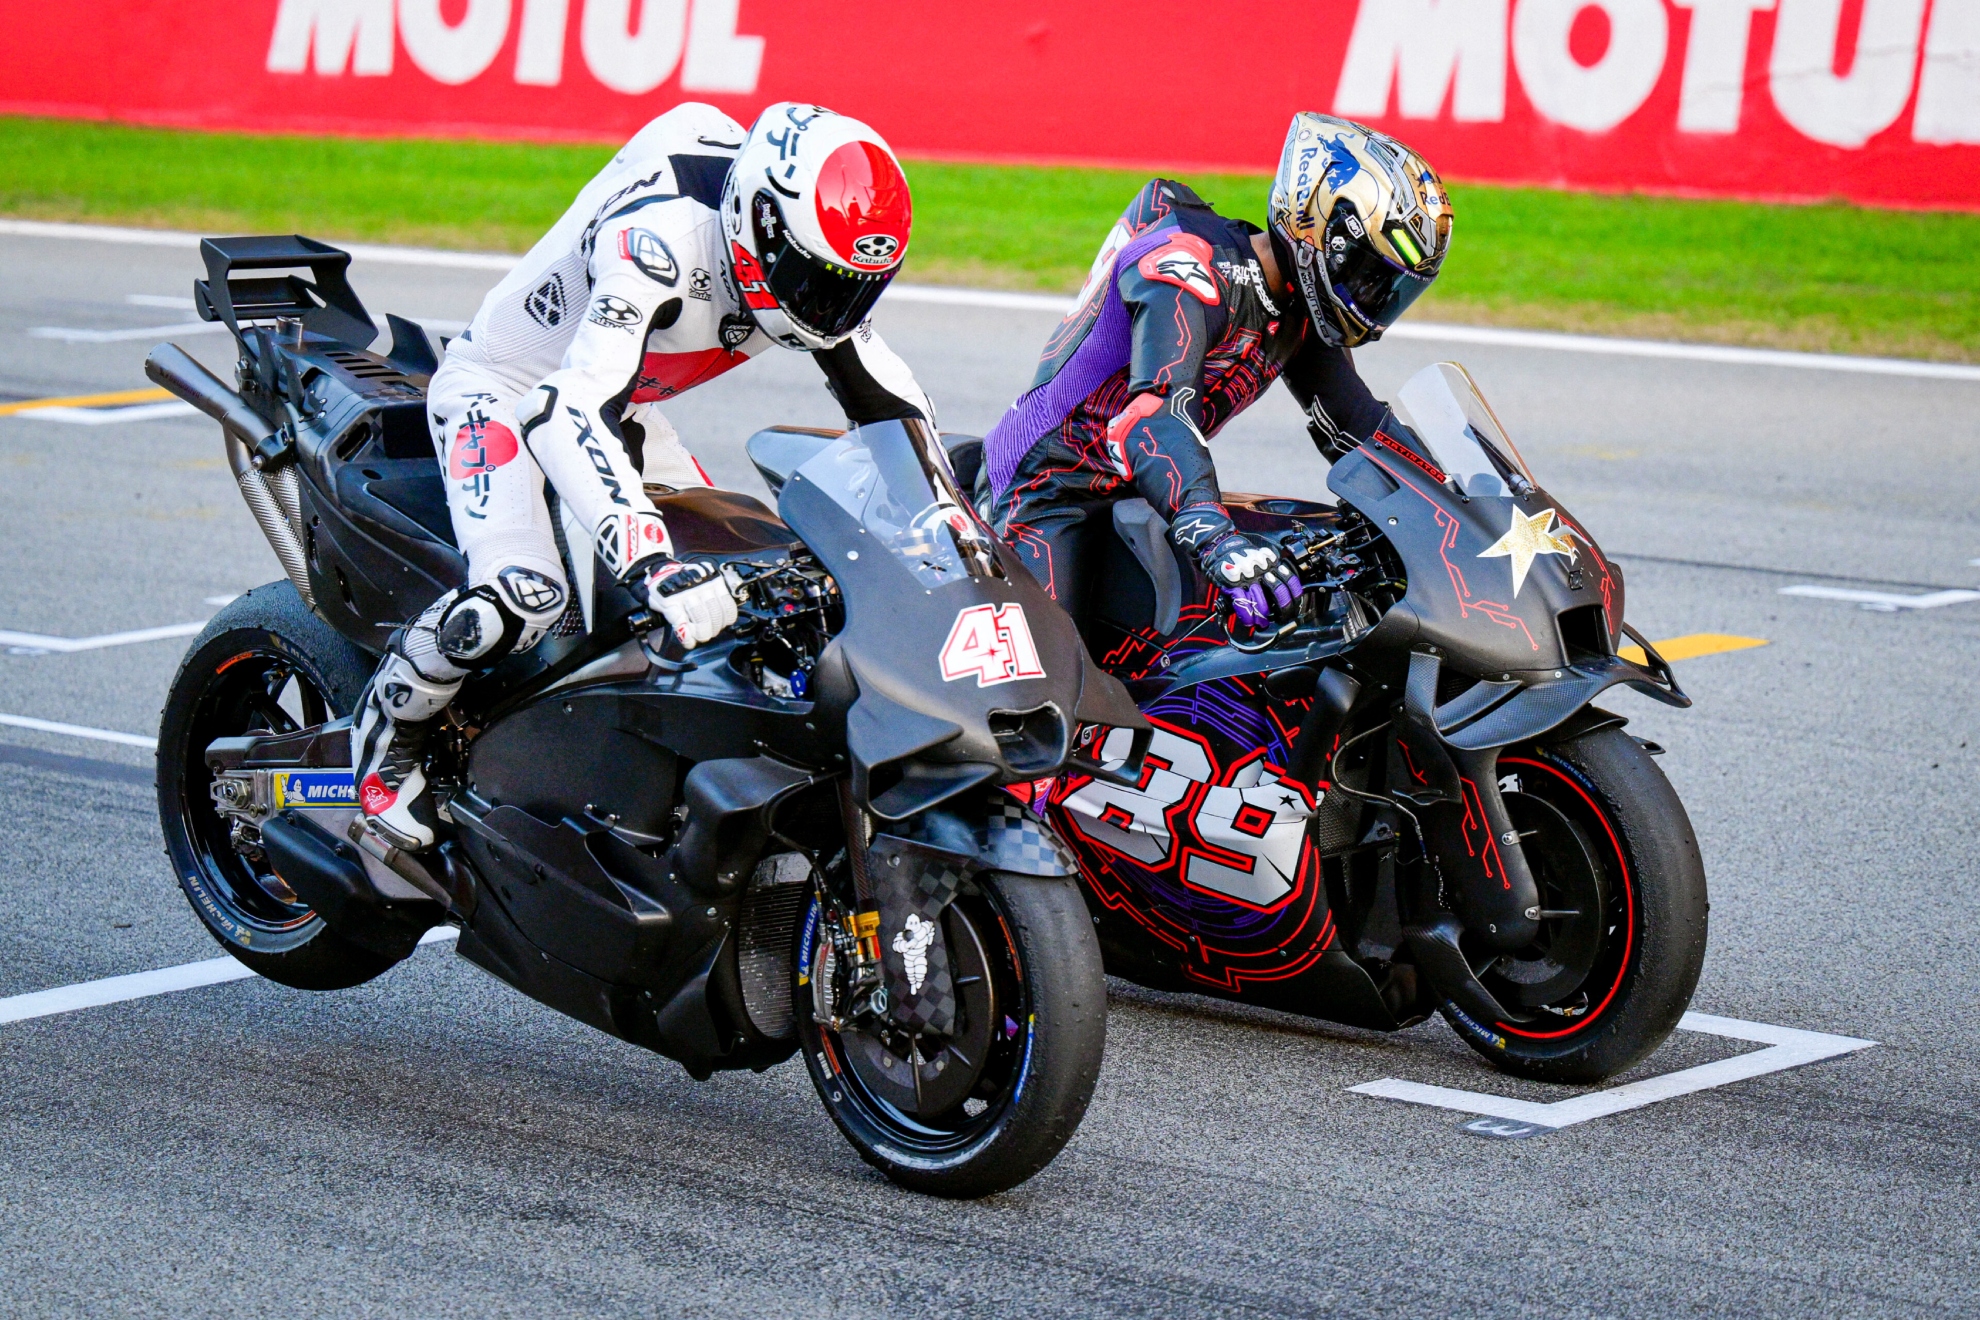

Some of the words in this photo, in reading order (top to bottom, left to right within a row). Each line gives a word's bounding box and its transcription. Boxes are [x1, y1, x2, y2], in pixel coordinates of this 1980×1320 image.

[852, 254, 894, 264] Kabuto
[1247, 258, 1281, 317] alpinestars
[565, 405, 632, 508] IXON
[1376, 432, 1447, 483] MARTINATOR
[938, 603, 1047, 688] 41
[1552, 755, 1593, 789] MICHELIN
[1054, 713, 1320, 914] 89
[187, 875, 235, 932] MICHELIN
[802, 904, 818, 963] MICHELIN
[1448, 1001, 1491, 1039] MICHELIN
